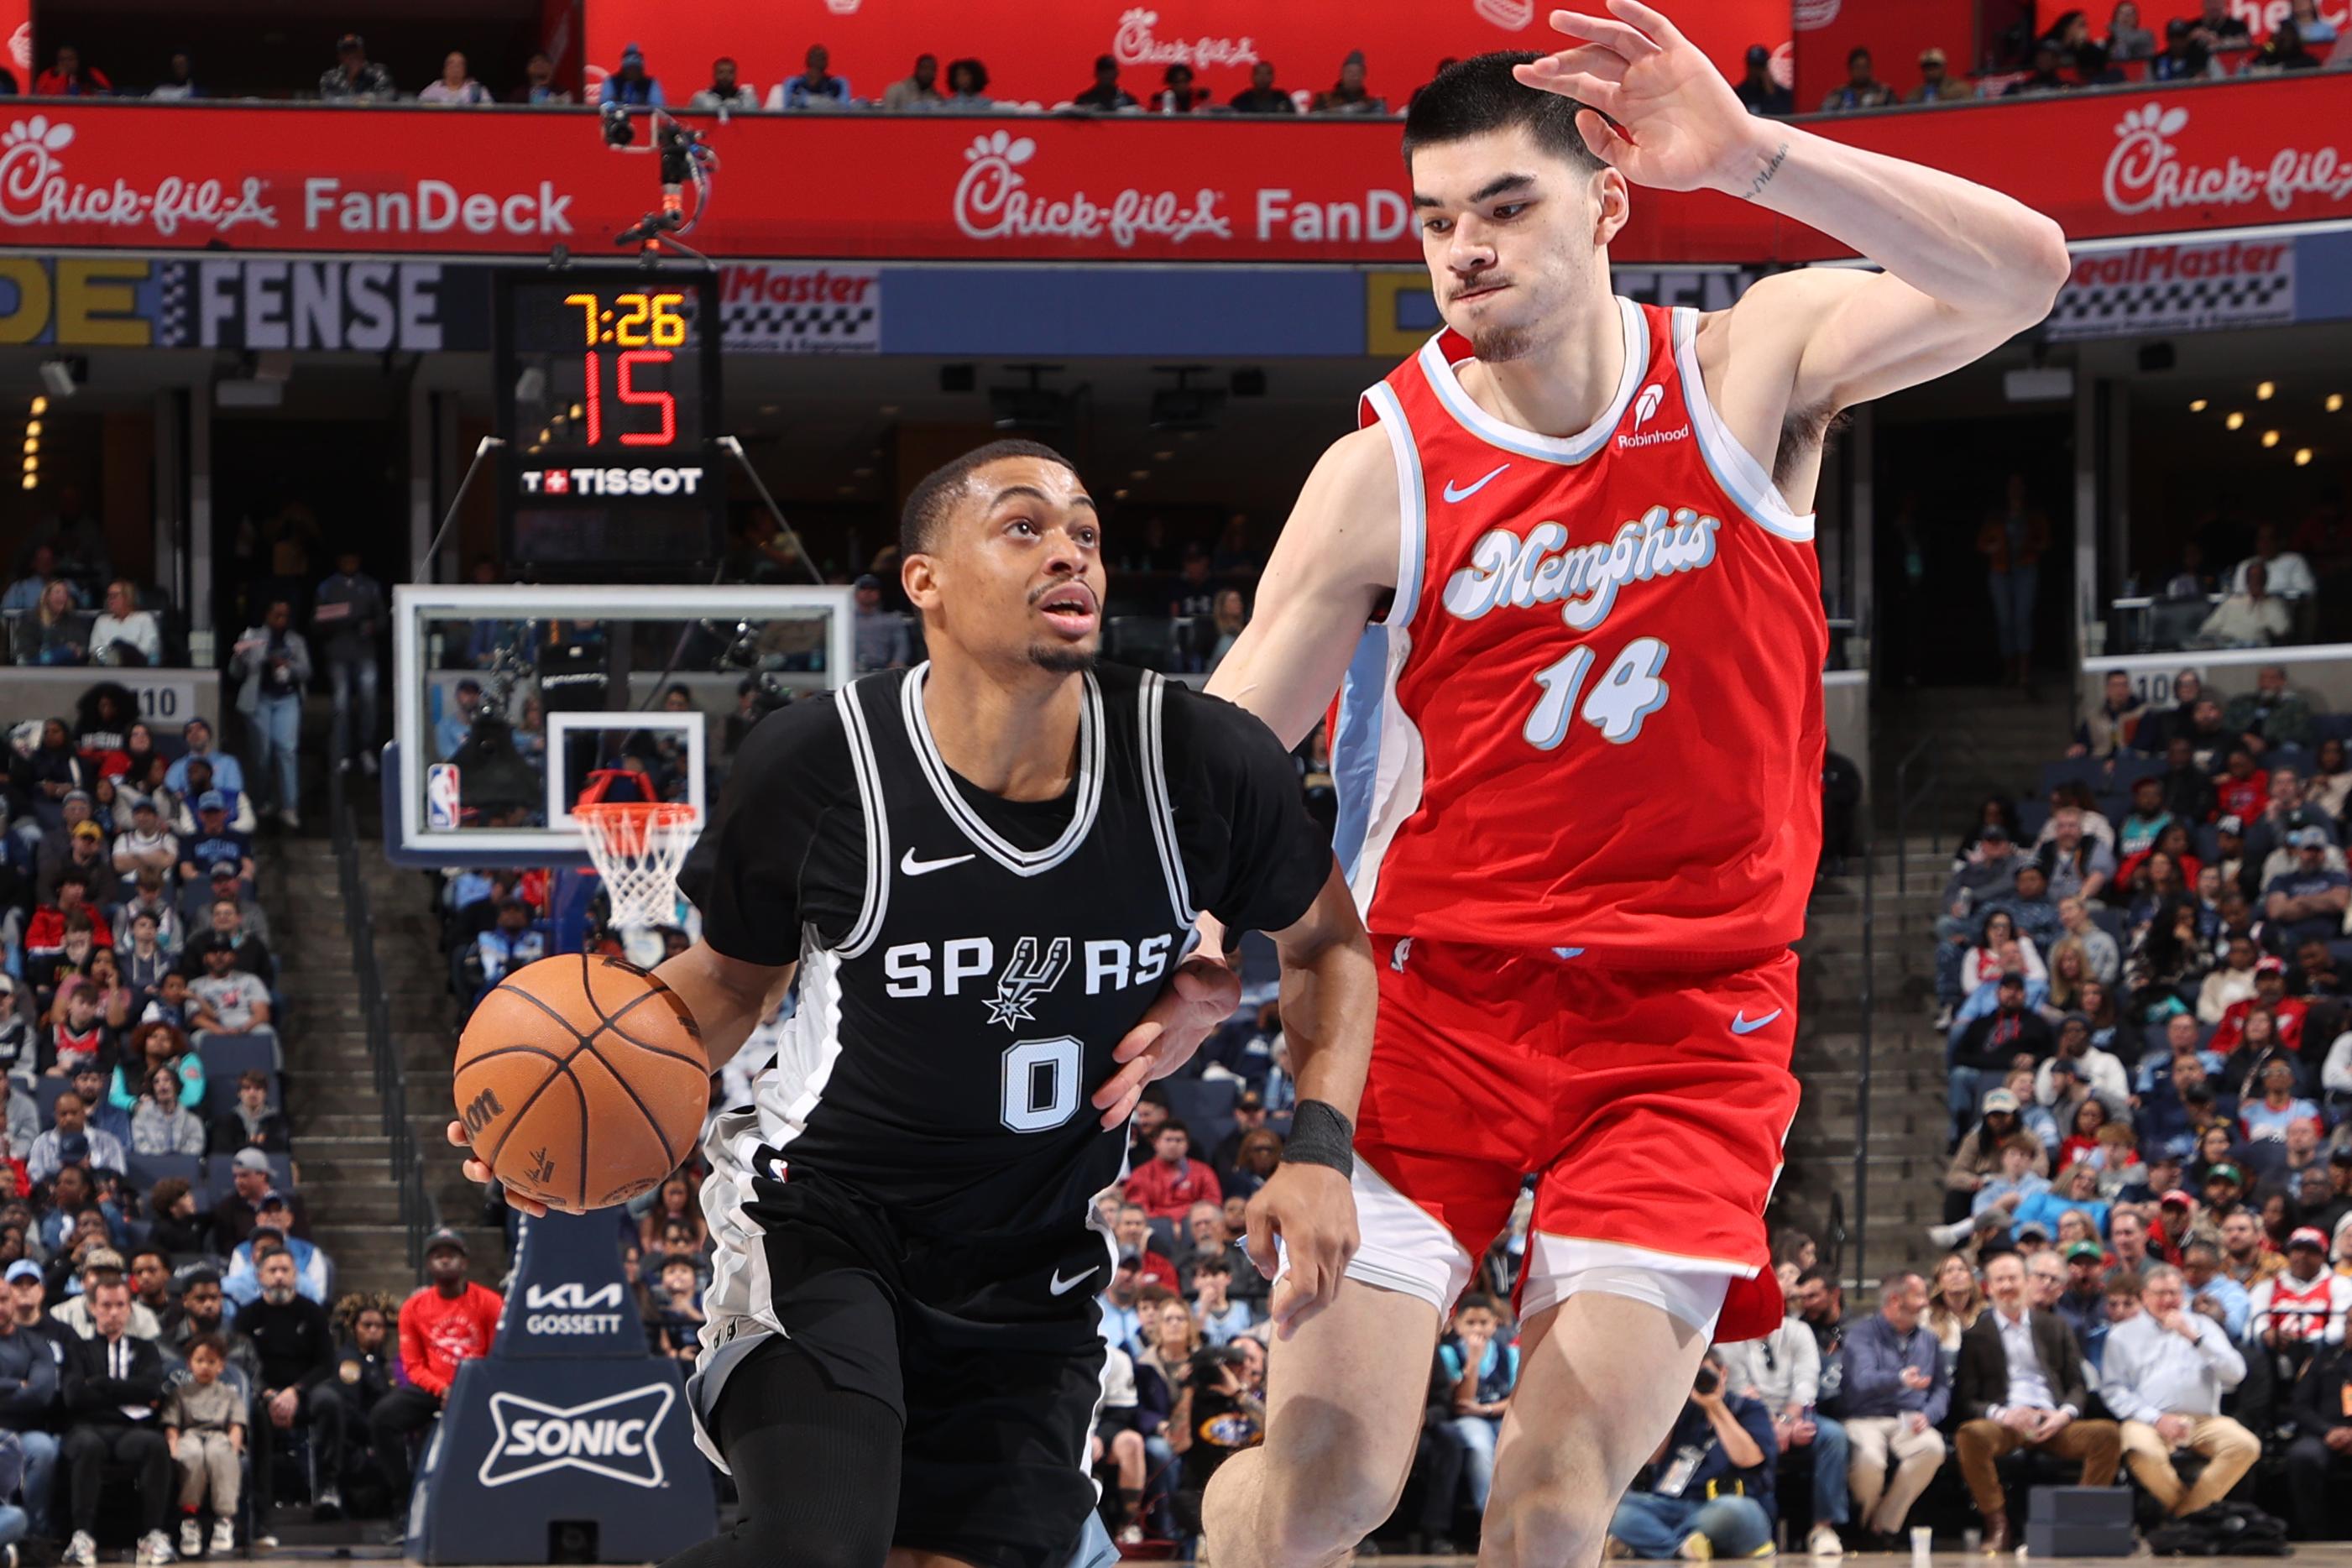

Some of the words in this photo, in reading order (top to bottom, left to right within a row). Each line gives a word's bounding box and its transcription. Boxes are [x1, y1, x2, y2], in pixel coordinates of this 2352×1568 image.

[1113, 13, 1258, 69] Chick-fil-A
[0, 126, 278, 236] Chick-fil-A
[304, 177, 575, 234] FanDeck
[954, 141, 1232, 247] Chick-fil-A
[1256, 188, 1424, 243] FanD
[719, 266, 875, 305] lMaster
[2068, 241, 2288, 288] ealMaster
[199, 262, 443, 350] FENSE
[564, 293, 687, 347] 7:26
[585, 350, 675, 446] 15
[1618, 425, 1690, 449] Robinhood
[572, 468, 703, 495] TISSOT
[1442, 504, 1722, 631] Memphis
[1523, 636, 1670, 751] 14
[2137, 675, 2170, 704] 10
[884, 933, 1173, 1017] SPURS
[999, 1034, 1085, 1134] 0
[526, 1283, 623, 1309] KIA
[526, 1315, 623, 1335] GOSSETT
[504, 1419, 646, 1457] SONIC
